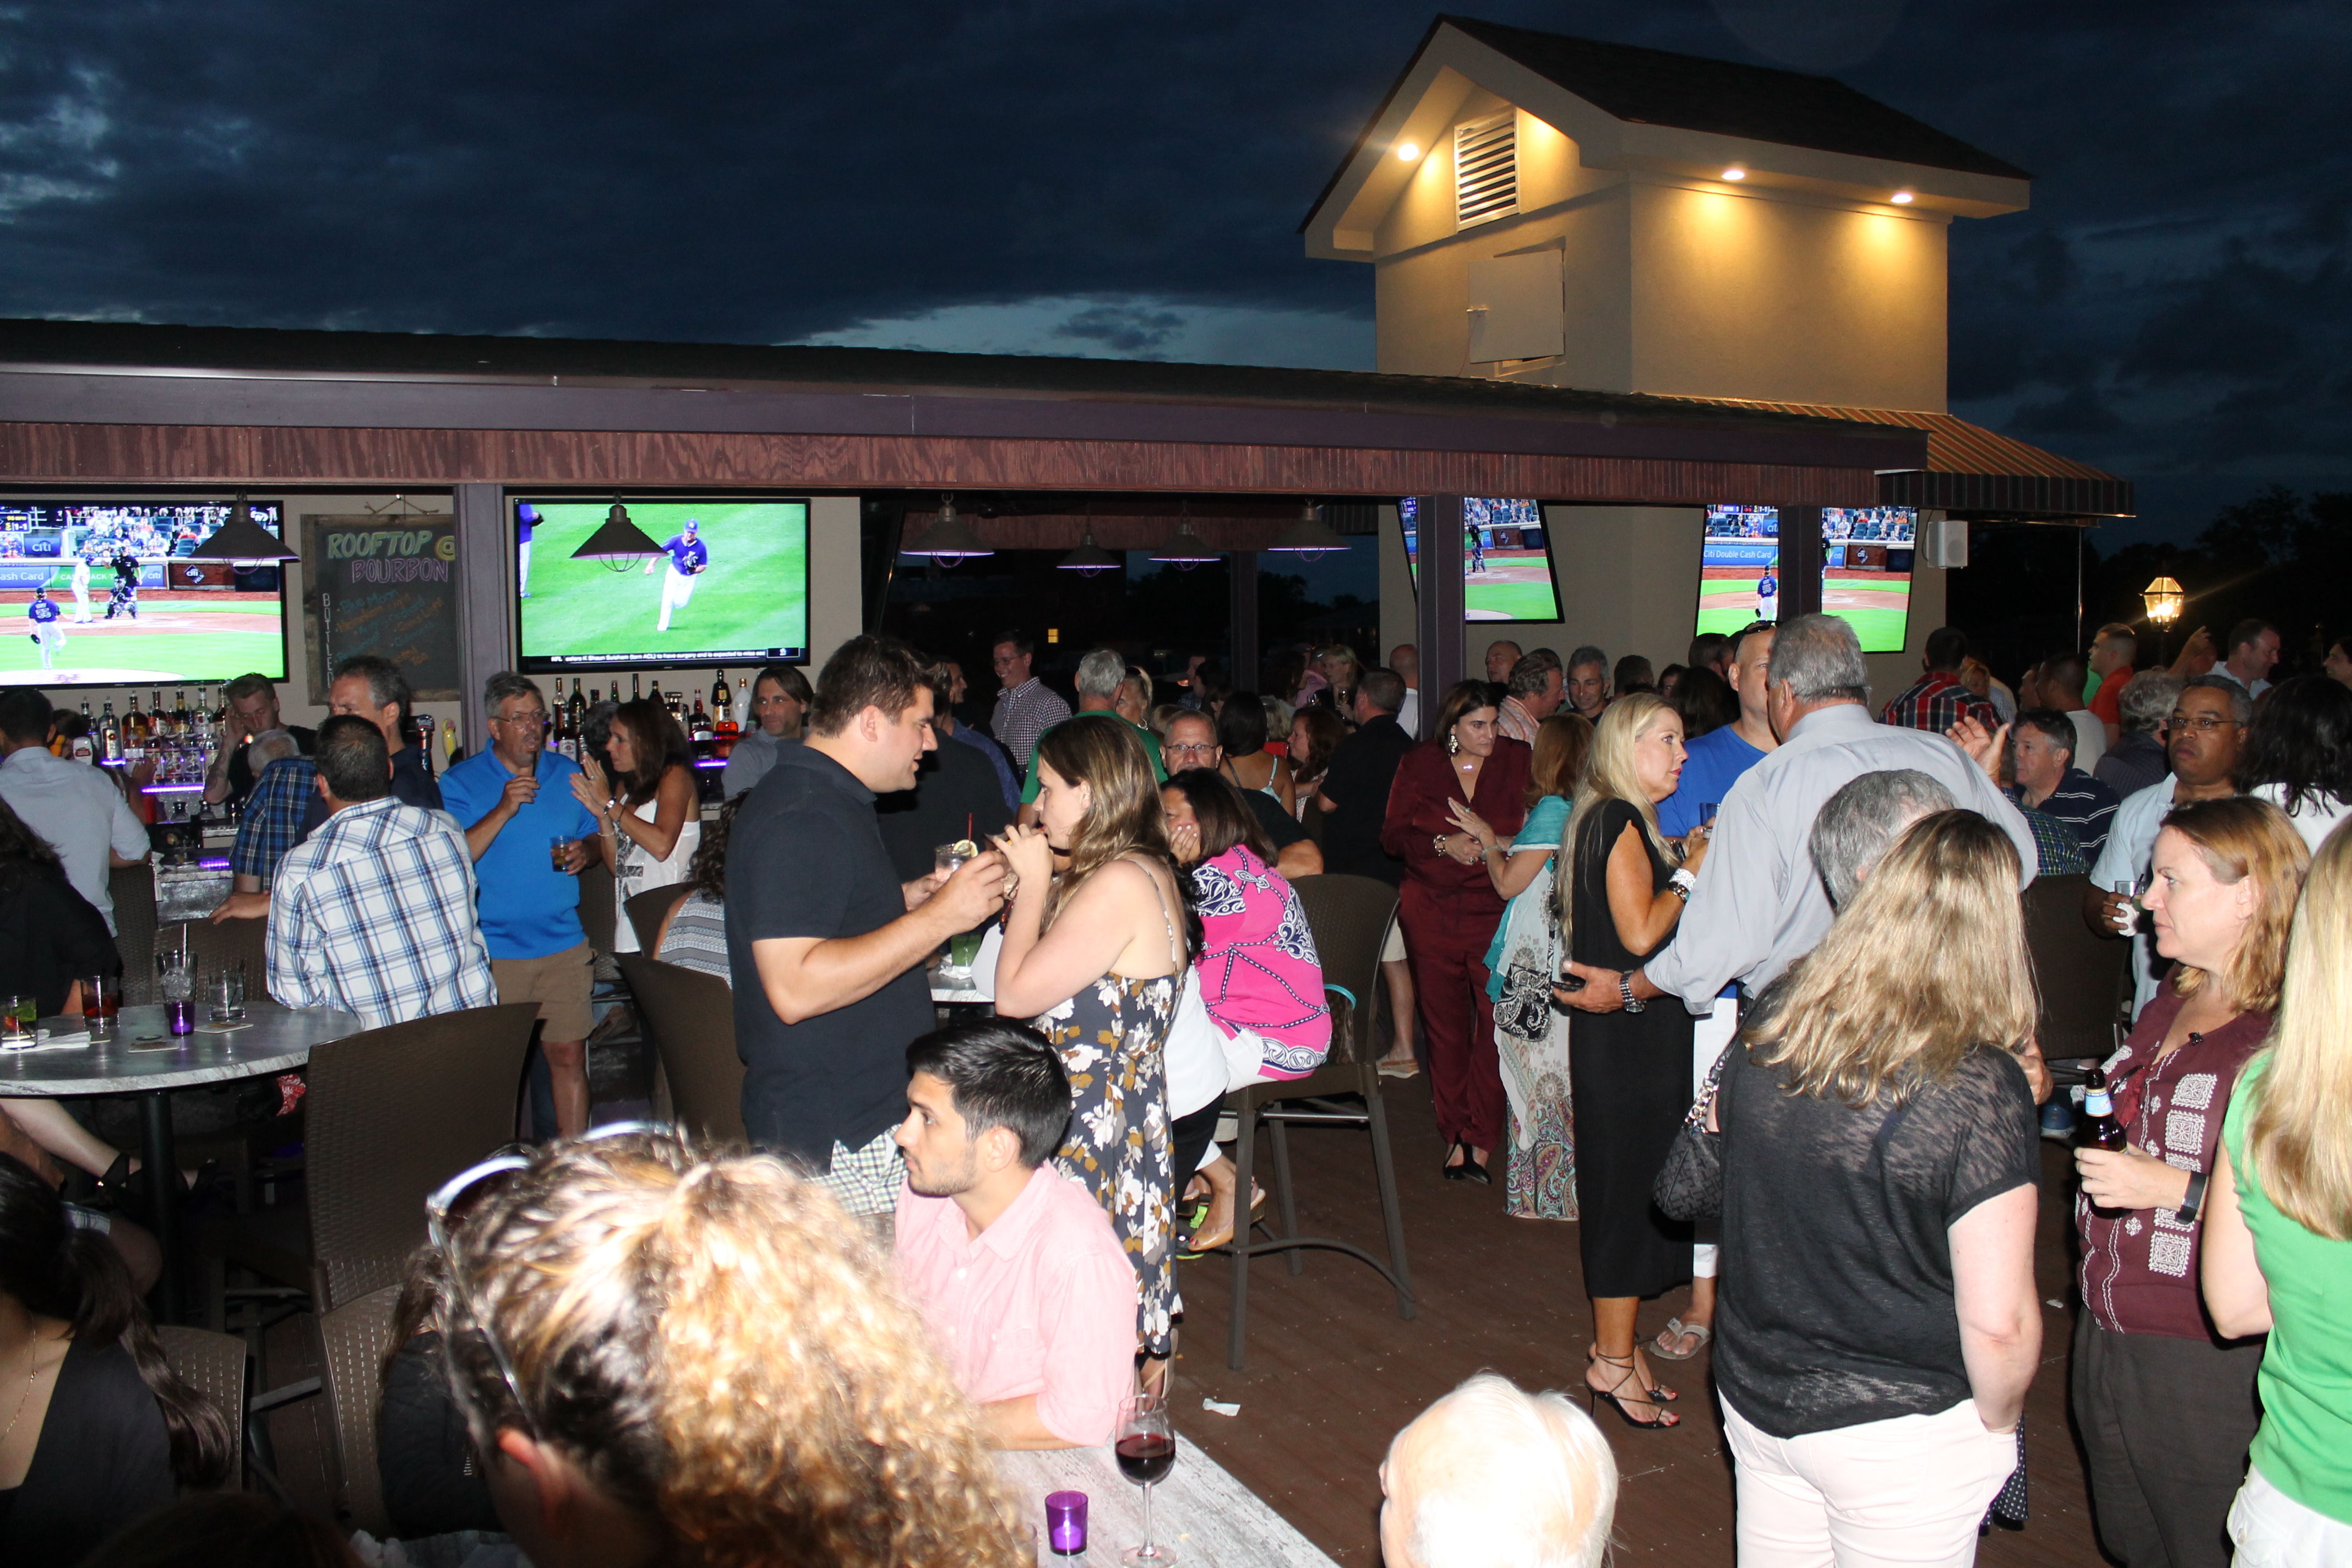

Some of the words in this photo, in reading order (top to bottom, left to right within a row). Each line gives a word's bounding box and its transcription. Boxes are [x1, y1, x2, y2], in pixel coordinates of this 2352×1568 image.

[1767, 524, 1778, 532] cit
[32, 541, 51, 552] citi
[328, 530, 433, 559] ROOFTOP
[434, 536, 455, 562] @
[1716, 550, 1739, 558] Double
[1740, 550, 1755, 558] Cash
[186, 569, 198, 577] citi
[352, 557, 449, 584] BOURBON
[0, 572, 18, 580] ash
[20, 572, 45, 580] Card
[35, 608, 52, 619] 55
